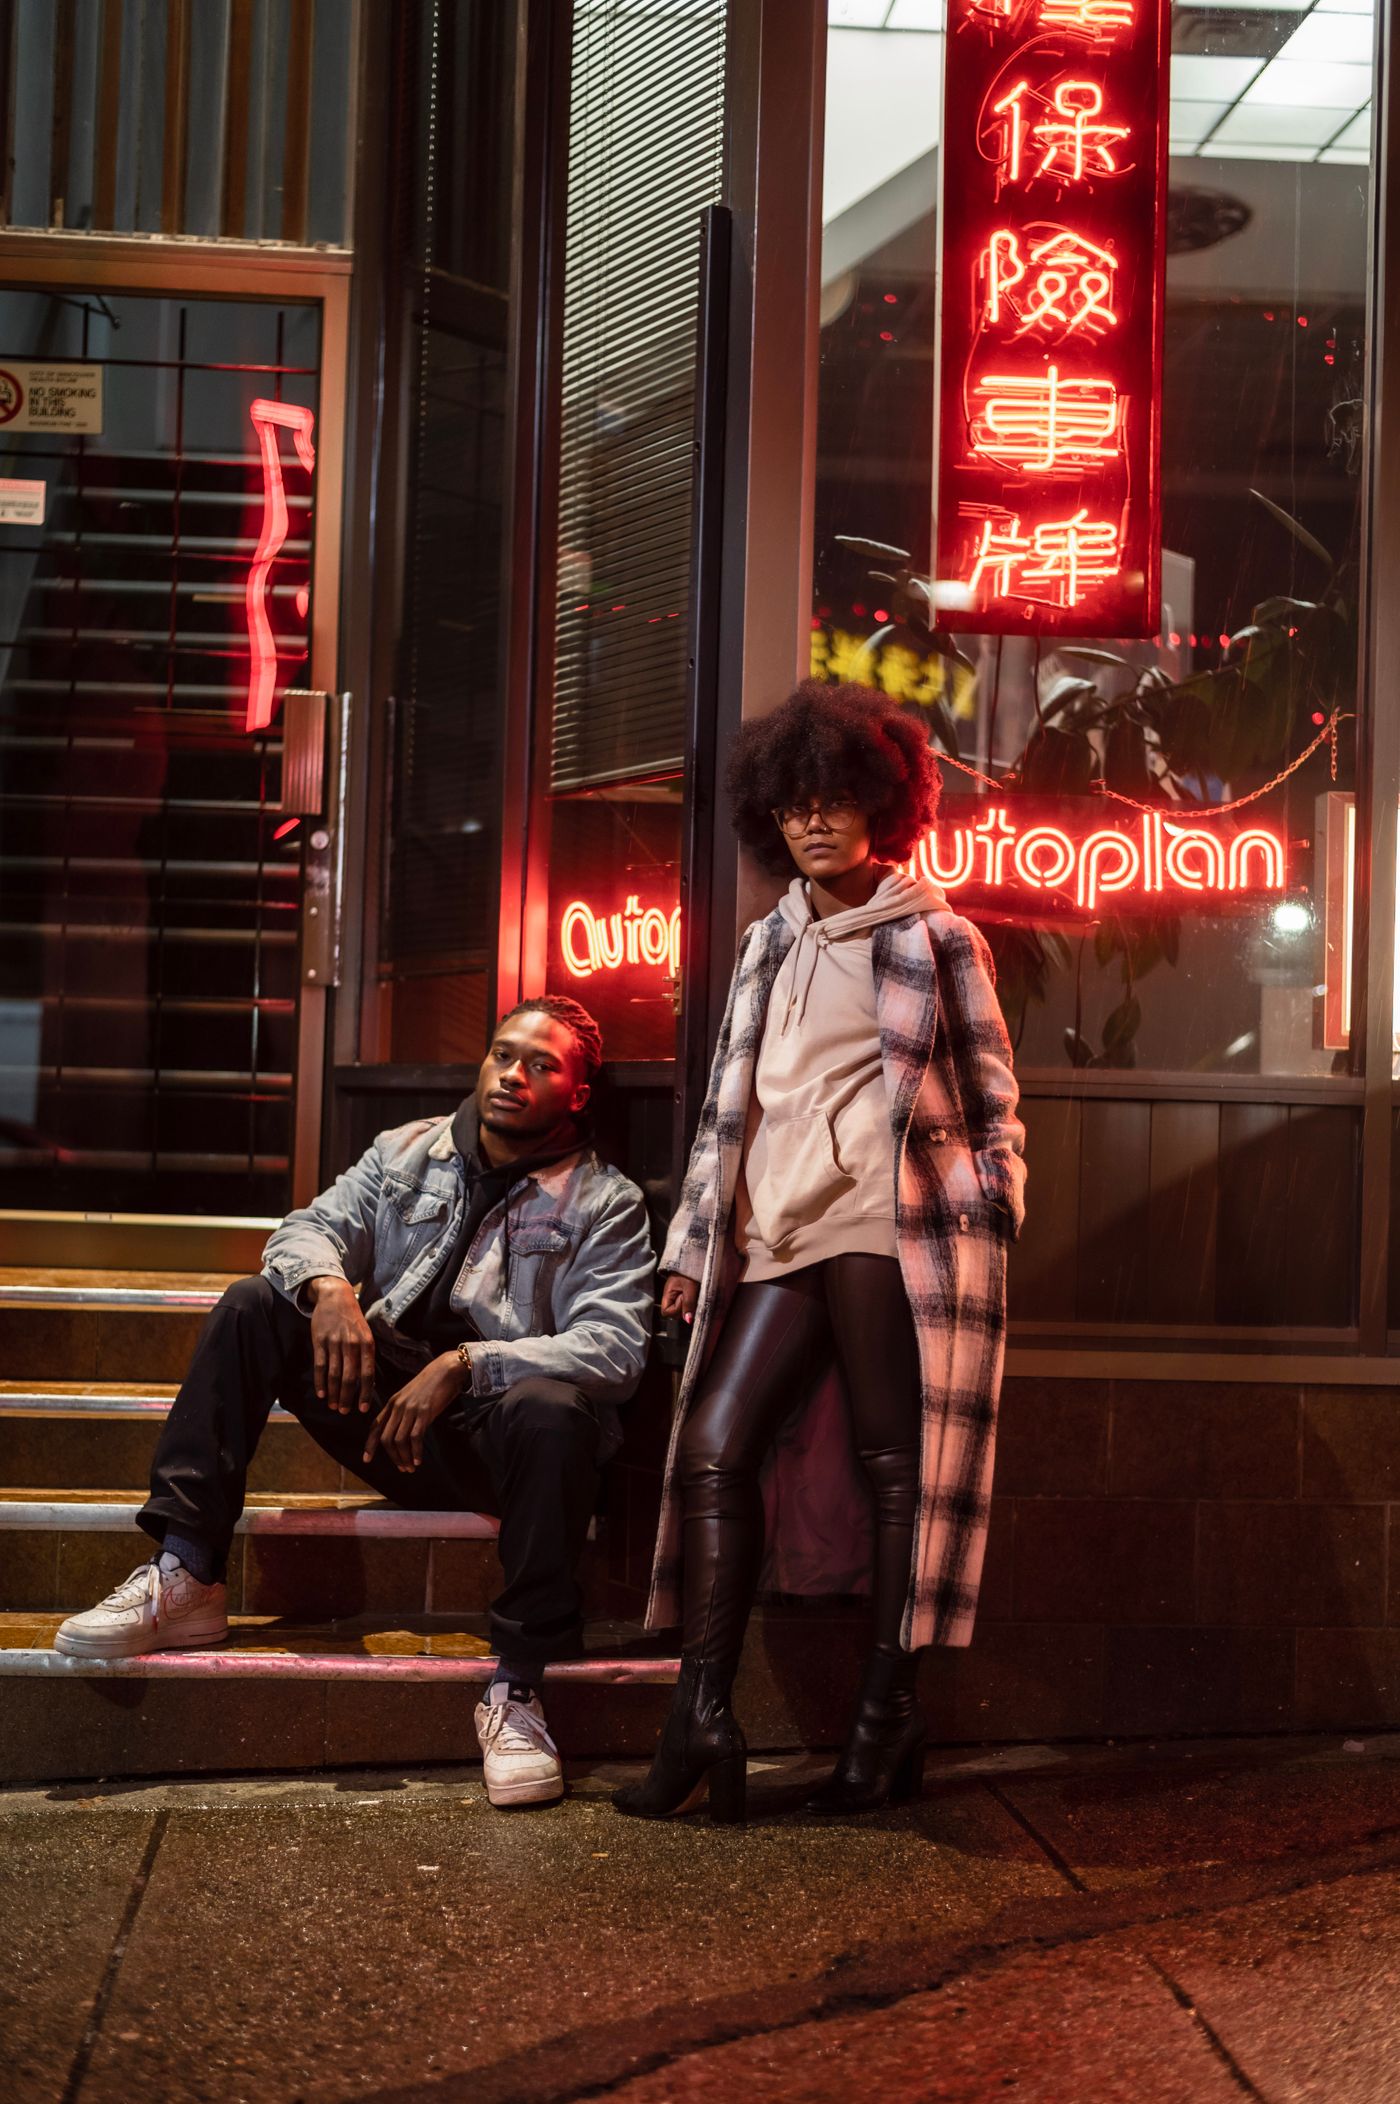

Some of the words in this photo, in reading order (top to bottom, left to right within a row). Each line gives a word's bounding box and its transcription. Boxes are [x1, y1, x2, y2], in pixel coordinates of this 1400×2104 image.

[966, 0, 1134, 607] 保險車牌
[29, 387, 44, 397] NO
[48, 387, 97, 400] SMOKING
[29, 398, 40, 407] IN
[43, 397, 65, 408] THIS
[29, 407, 77, 418] BUILDING
[897, 807, 1286, 909] utoplan
